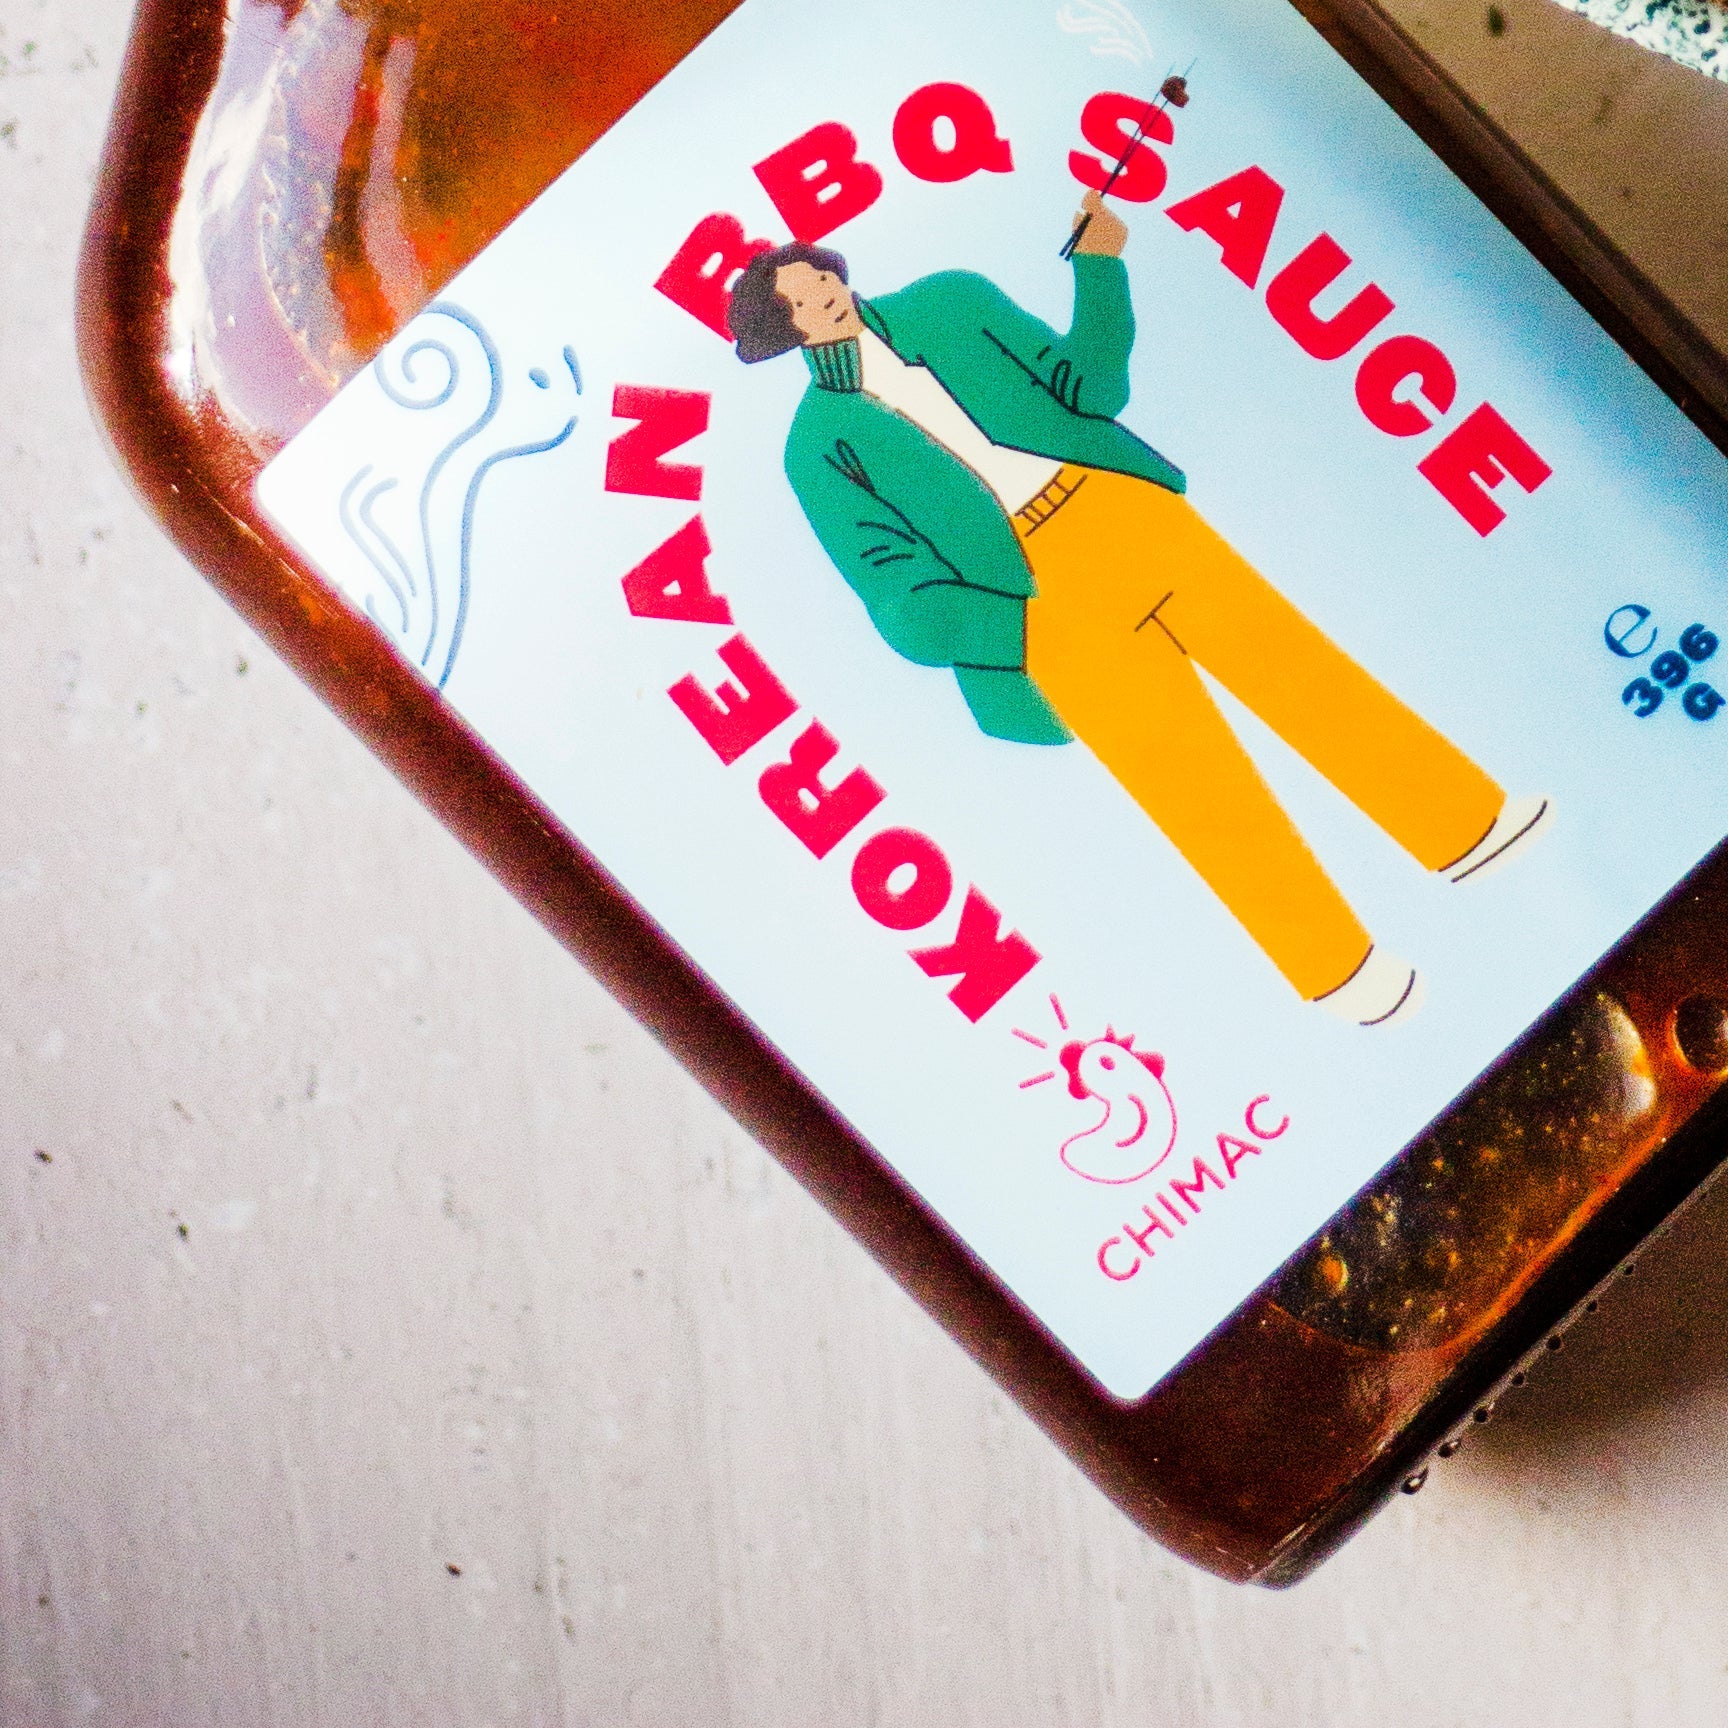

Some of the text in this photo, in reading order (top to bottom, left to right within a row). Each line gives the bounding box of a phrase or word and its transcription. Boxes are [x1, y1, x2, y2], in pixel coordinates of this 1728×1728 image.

[603, 81, 1554, 1023] KOREAN BBQ SAUCE
[1621, 622, 1719, 718] 396
[1097, 1093, 1290, 1281] CHIMAC
